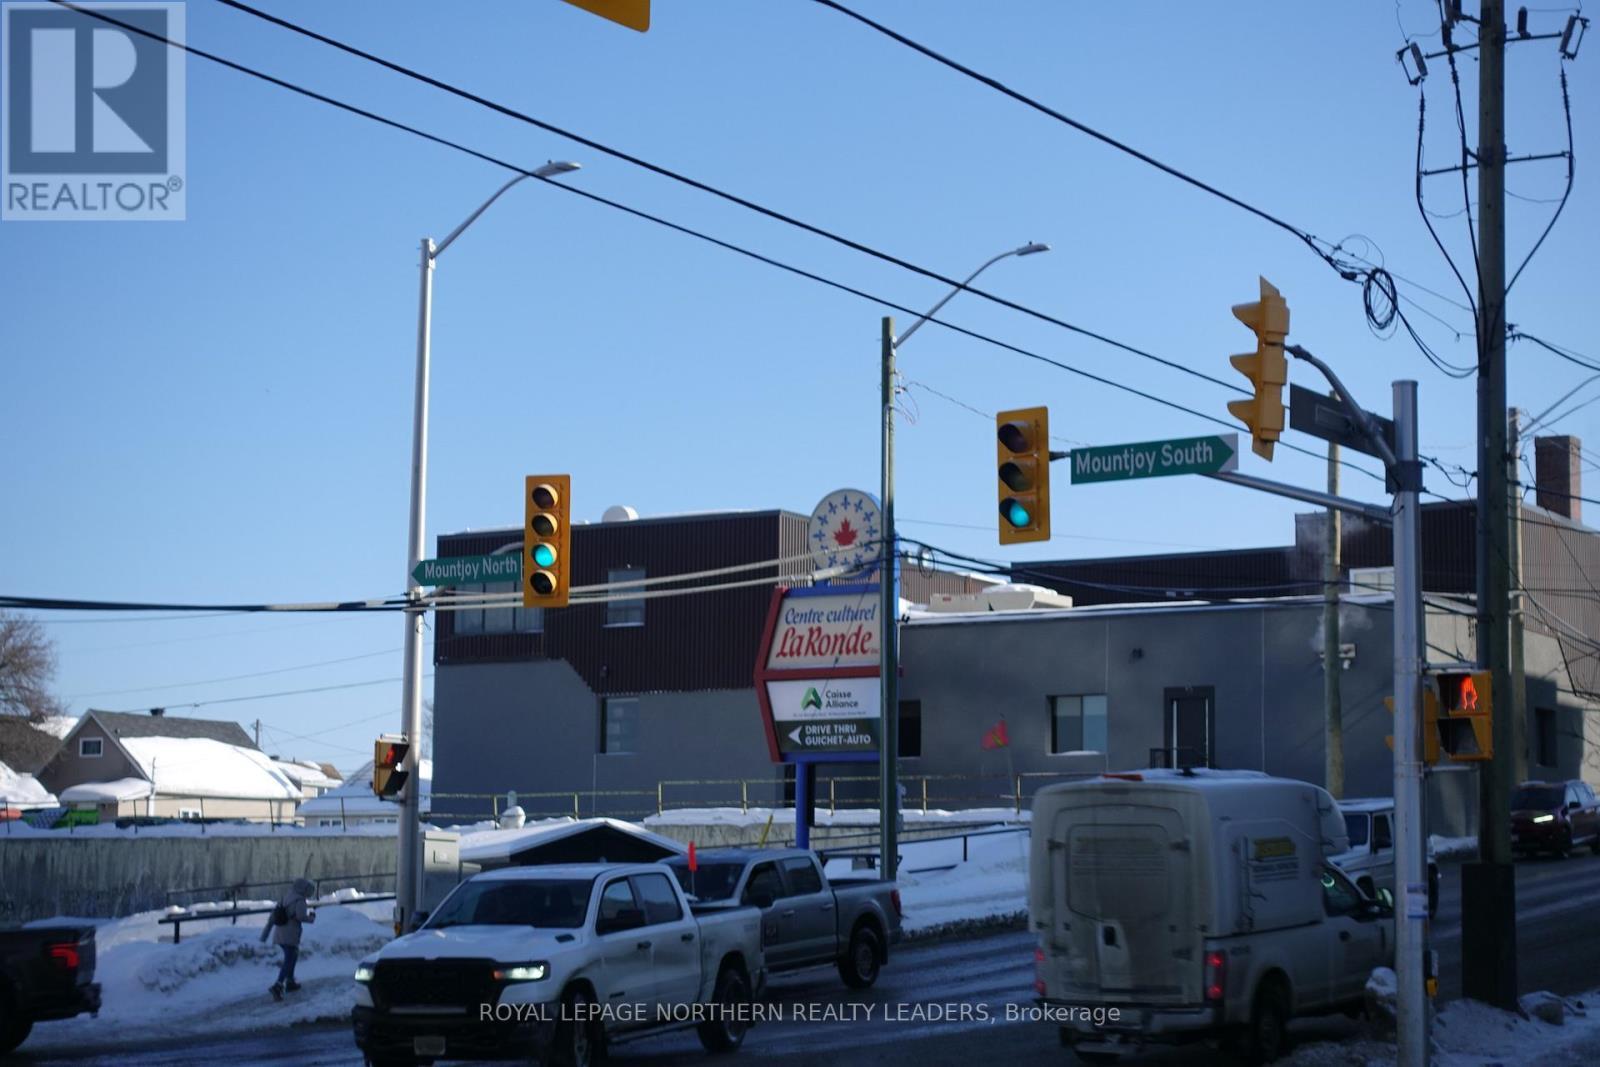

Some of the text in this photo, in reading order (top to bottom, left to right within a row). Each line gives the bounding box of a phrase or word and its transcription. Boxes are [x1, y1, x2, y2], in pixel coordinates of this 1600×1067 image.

[1076, 441, 1213, 476] Mountjoy South
[424, 557, 518, 580] Mountjoy North
[785, 603, 877, 625] Centre culturel
[825, 690, 852, 699] Caisse
[825, 700, 859, 709] Alliance
[805, 723, 857, 734] DRIVE THRU
[805, 734, 871, 746] GUICHET-AUTO
